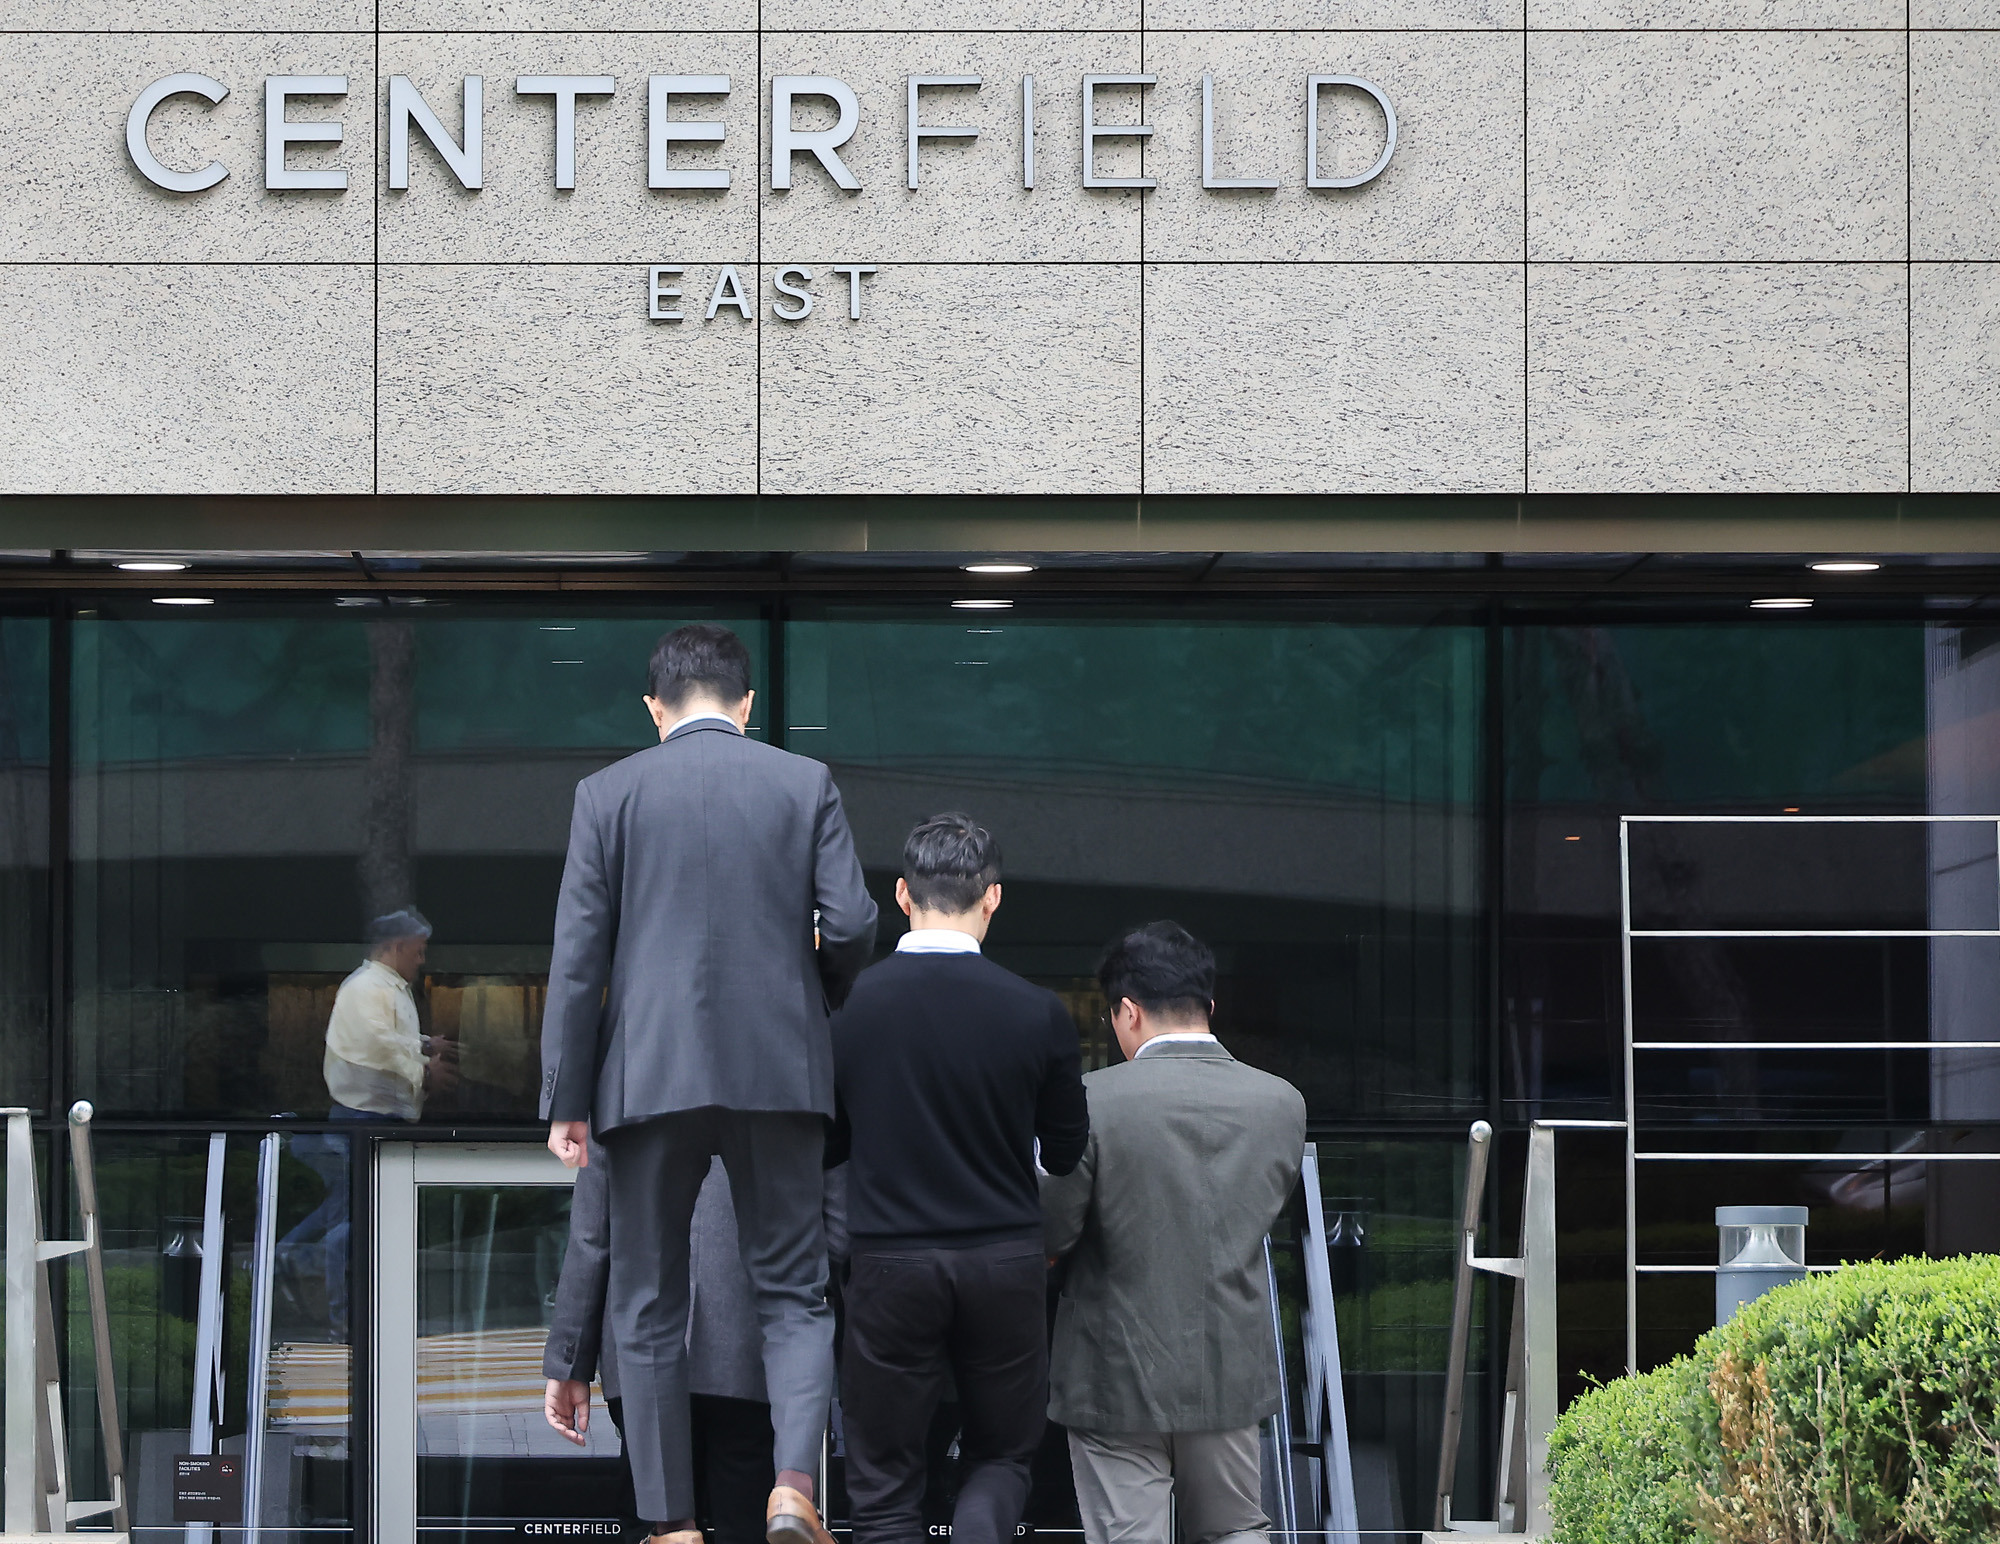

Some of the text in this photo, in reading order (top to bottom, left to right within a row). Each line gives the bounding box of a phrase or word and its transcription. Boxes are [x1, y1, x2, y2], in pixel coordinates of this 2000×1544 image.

[125, 71, 1400, 193] CENTERFIELD
[648, 264, 878, 322] EAST
[524, 1523, 621, 1535] CENTERFIELD
